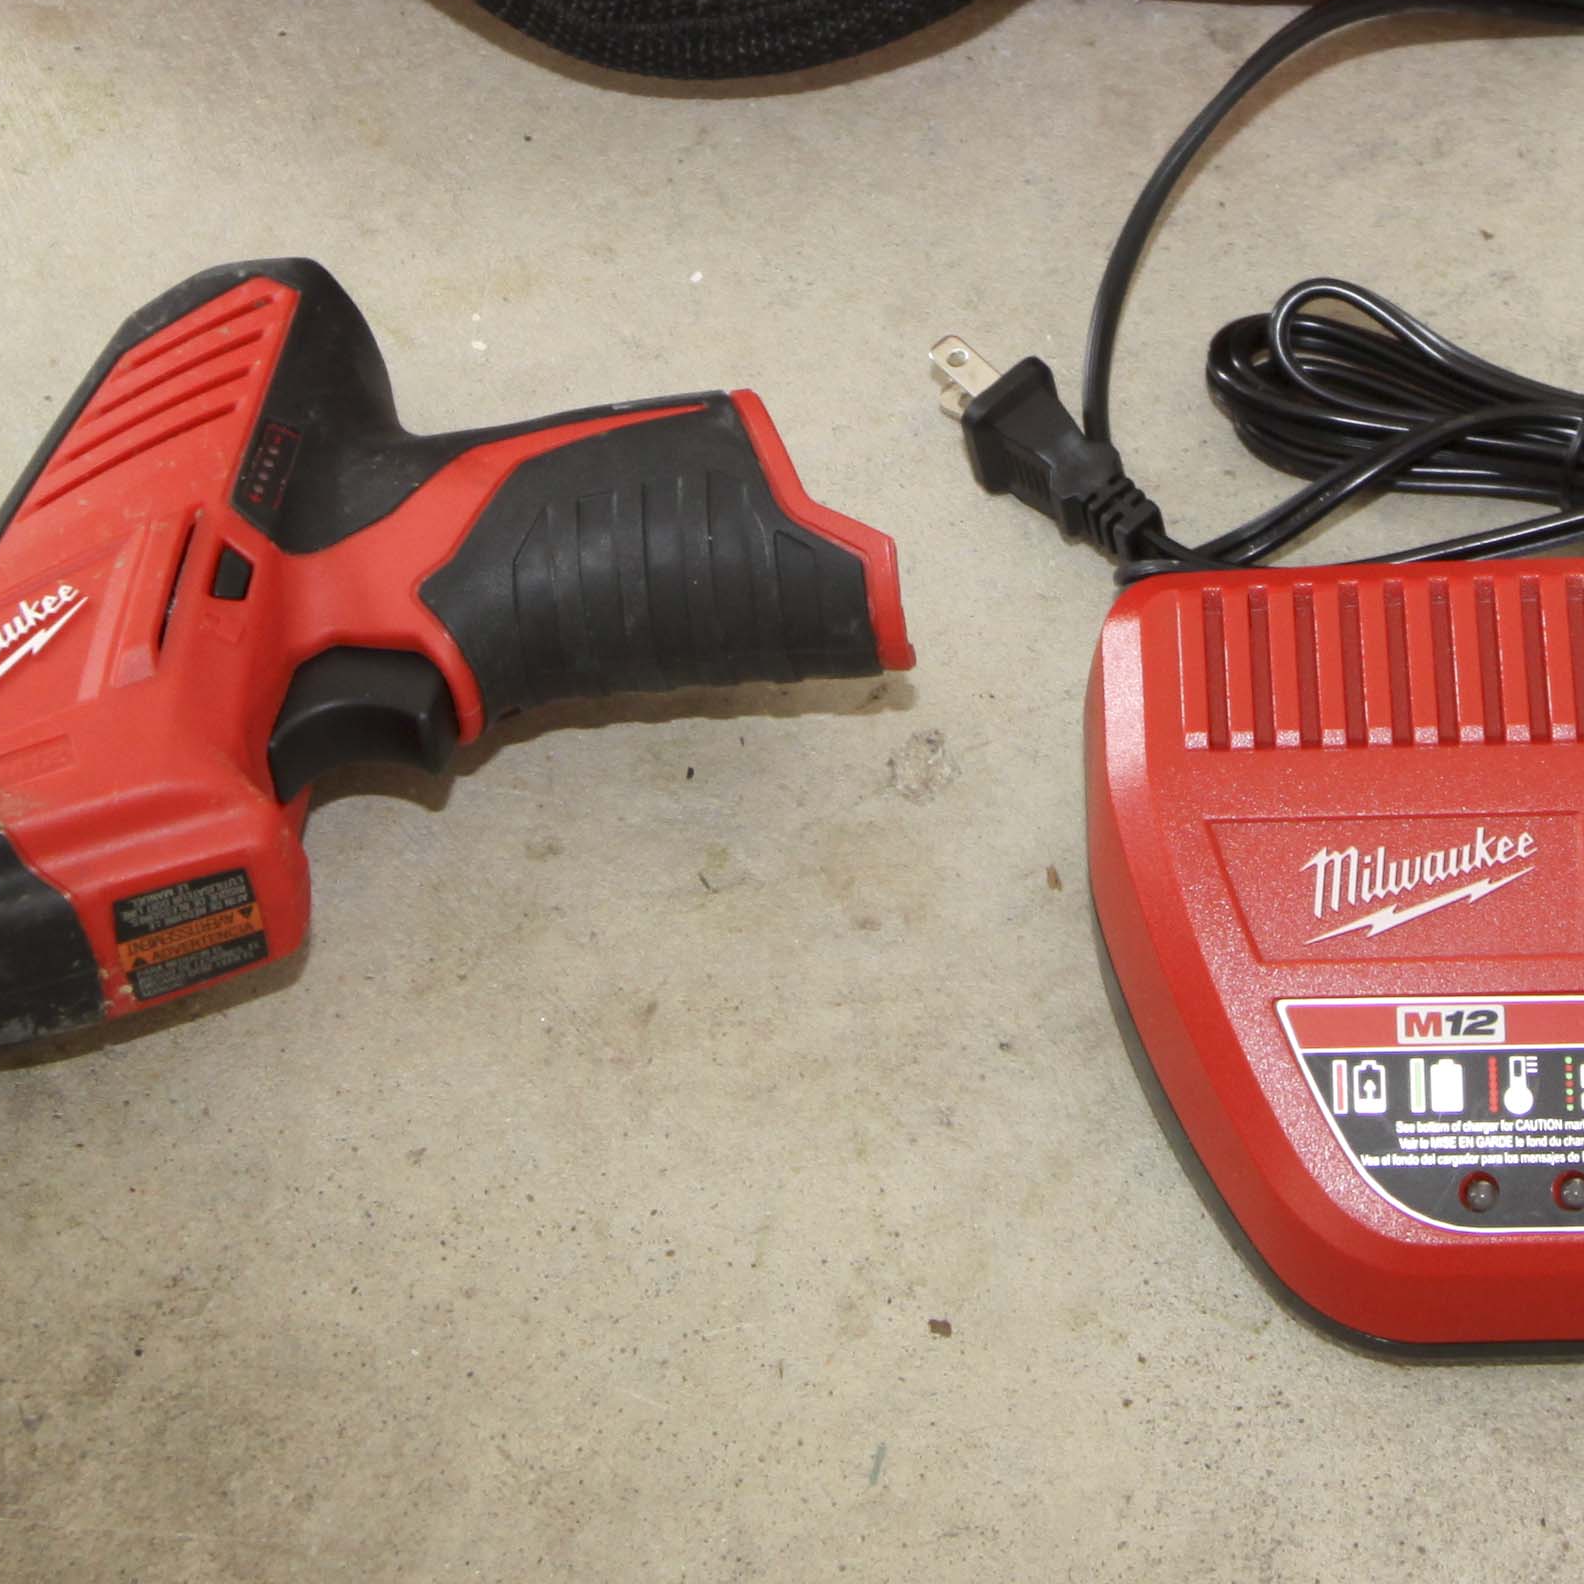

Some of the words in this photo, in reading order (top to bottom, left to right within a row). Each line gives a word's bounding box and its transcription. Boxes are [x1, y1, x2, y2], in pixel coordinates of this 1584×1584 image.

[1298, 826, 1538, 919] Milwaukee
[1404, 1009, 1498, 1038] M12
[1396, 1120, 1416, 1133] See
[1417, 1120, 1450, 1133] bottom
[1451, 1120, 1462, 1132] of
[1463, 1120, 1499, 1135] charger
[1500, 1119, 1514, 1132] for
[1516, 1119, 1563, 1131] CAUTION
[1430, 1136, 1457, 1149] MISE
[1459, 1136, 1475, 1148] EN
[1477, 1135, 1514, 1148] GARDE
[1526, 1135, 1548, 1147] fond
[1549, 1135, 1562, 1147] du
[1392, 1153, 1420, 1165] fondo
[1421, 1153, 1436, 1165] del
[1437, 1153, 1480, 1167] cargador
[1481, 1154, 1503, 1166] para
[1504, 1152, 1519, 1164] los
[1521, 1152, 1566, 1166] mensajes
[1567, 1152, 1580, 1163] de
